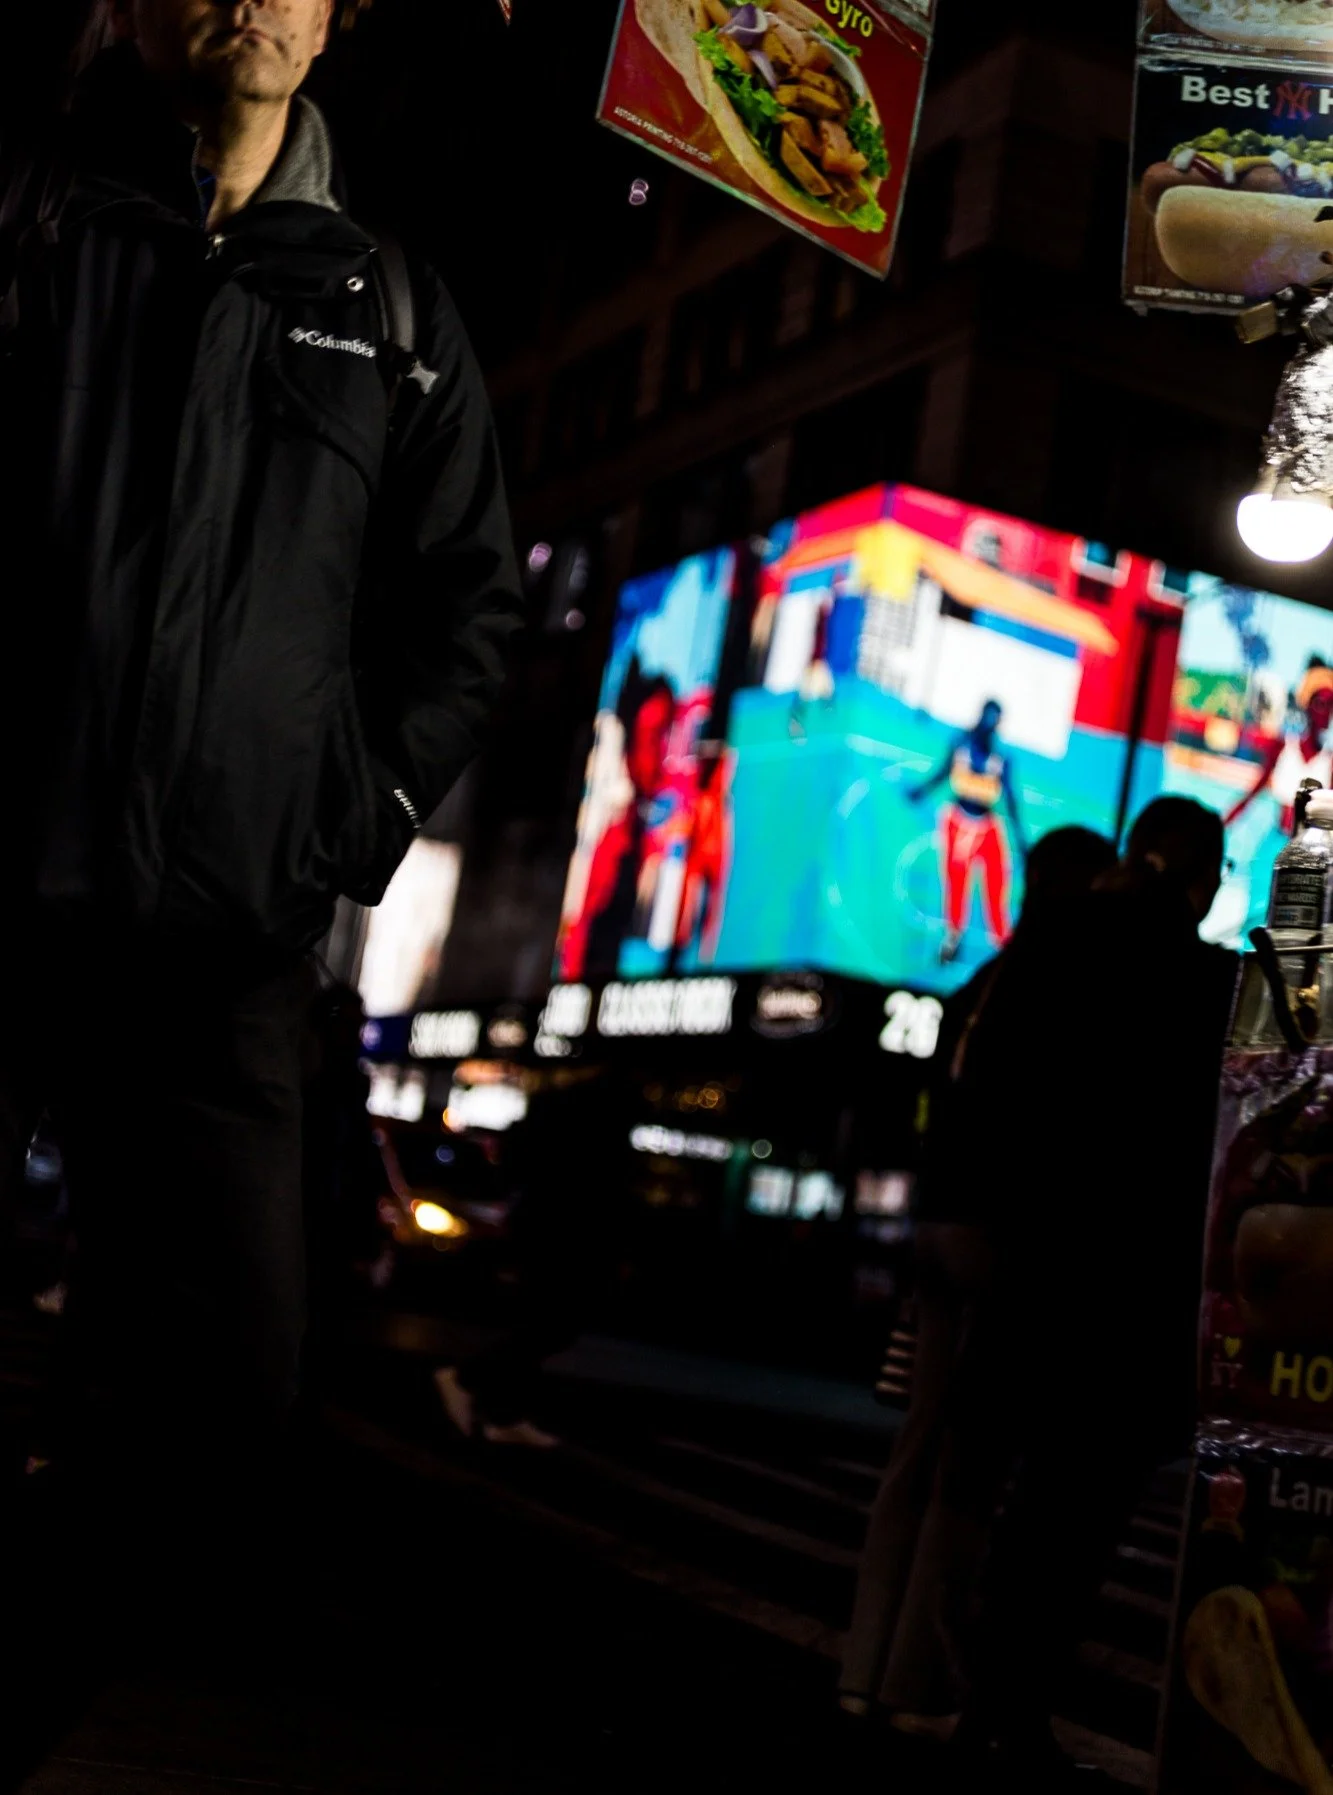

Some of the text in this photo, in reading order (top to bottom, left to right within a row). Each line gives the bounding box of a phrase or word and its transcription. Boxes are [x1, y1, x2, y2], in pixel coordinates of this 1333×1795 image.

[825, 0, 873, 37] Gyro
[1181, 75, 1270, 109] Best
[305, 329, 377, 358] Columbia
[1269, 1350, 1333, 1403] HO
